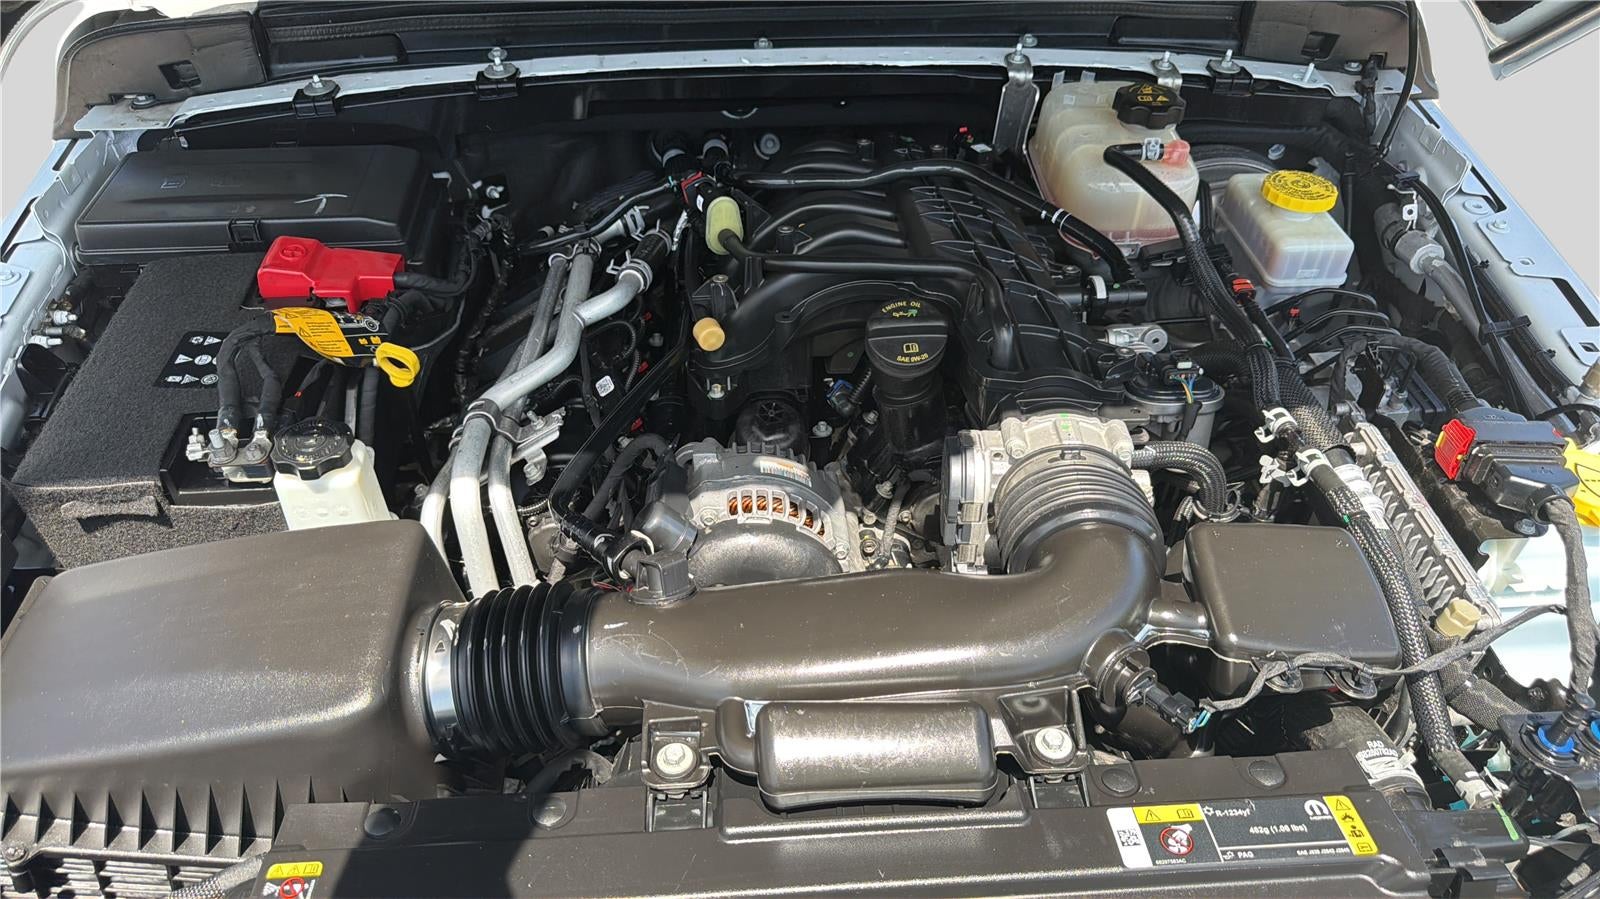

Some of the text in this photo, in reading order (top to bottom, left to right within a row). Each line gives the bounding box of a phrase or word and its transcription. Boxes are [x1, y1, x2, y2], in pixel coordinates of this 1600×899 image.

[881, 301, 907, 313] ENGINE
[896, 355, 910, 363] SAE
[1366, 740, 1385, 749] RAD
[1215, 808, 1250, 817] R-1234yf
[1290, 823, 1308, 833] lbs)
[1237, 850, 1254, 859] PAG
